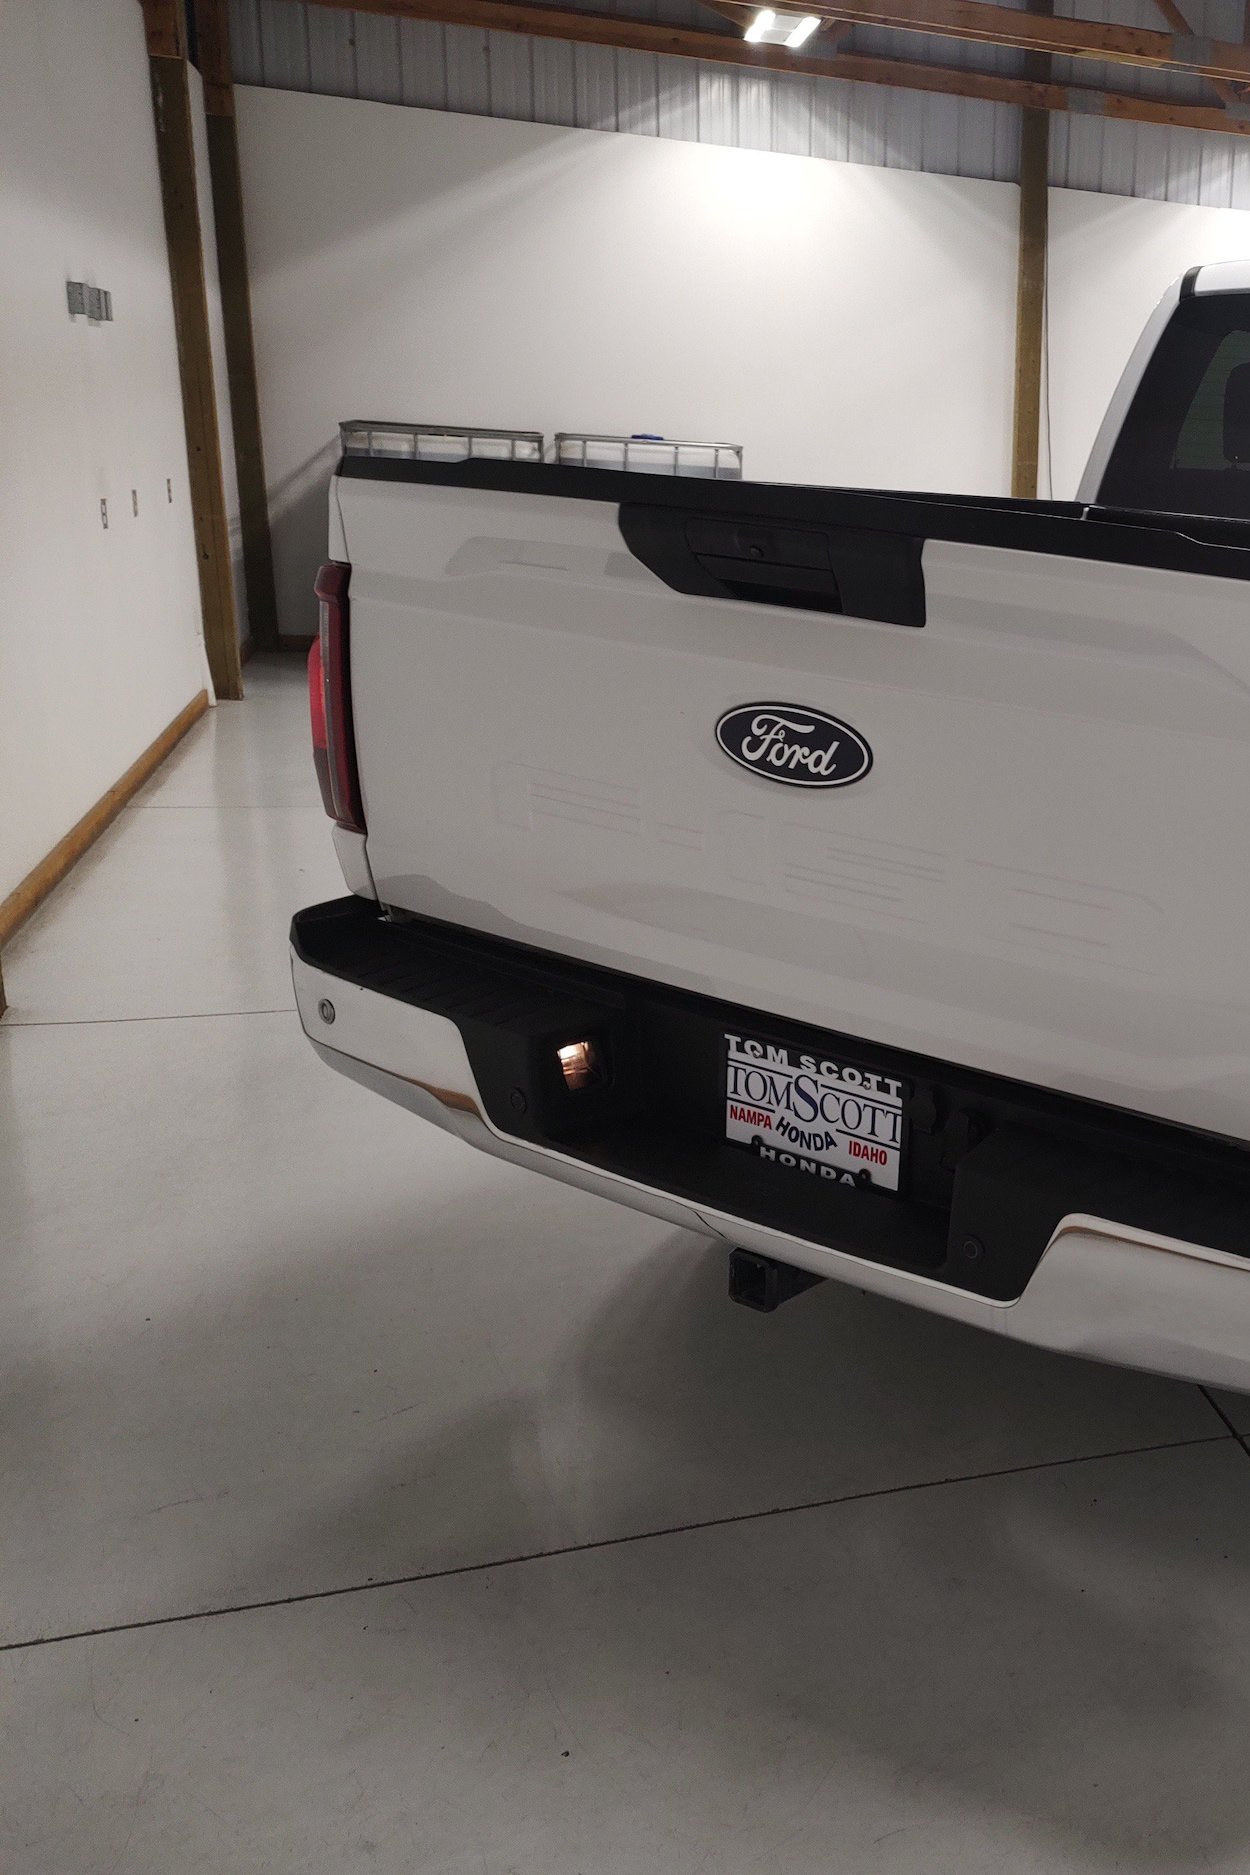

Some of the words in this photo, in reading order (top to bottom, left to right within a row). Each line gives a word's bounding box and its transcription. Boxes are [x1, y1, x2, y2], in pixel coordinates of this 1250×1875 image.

[741, 714, 840, 776] Ford
[724, 1033, 789, 1066] TOM
[799, 1055, 902, 1098] SCOTT
[729, 1104, 772, 1130] NAMPA
[775, 1116, 838, 1151] HONDA
[848, 1140, 888, 1166] IDAHO
[759, 1146, 857, 1188] HONDA
